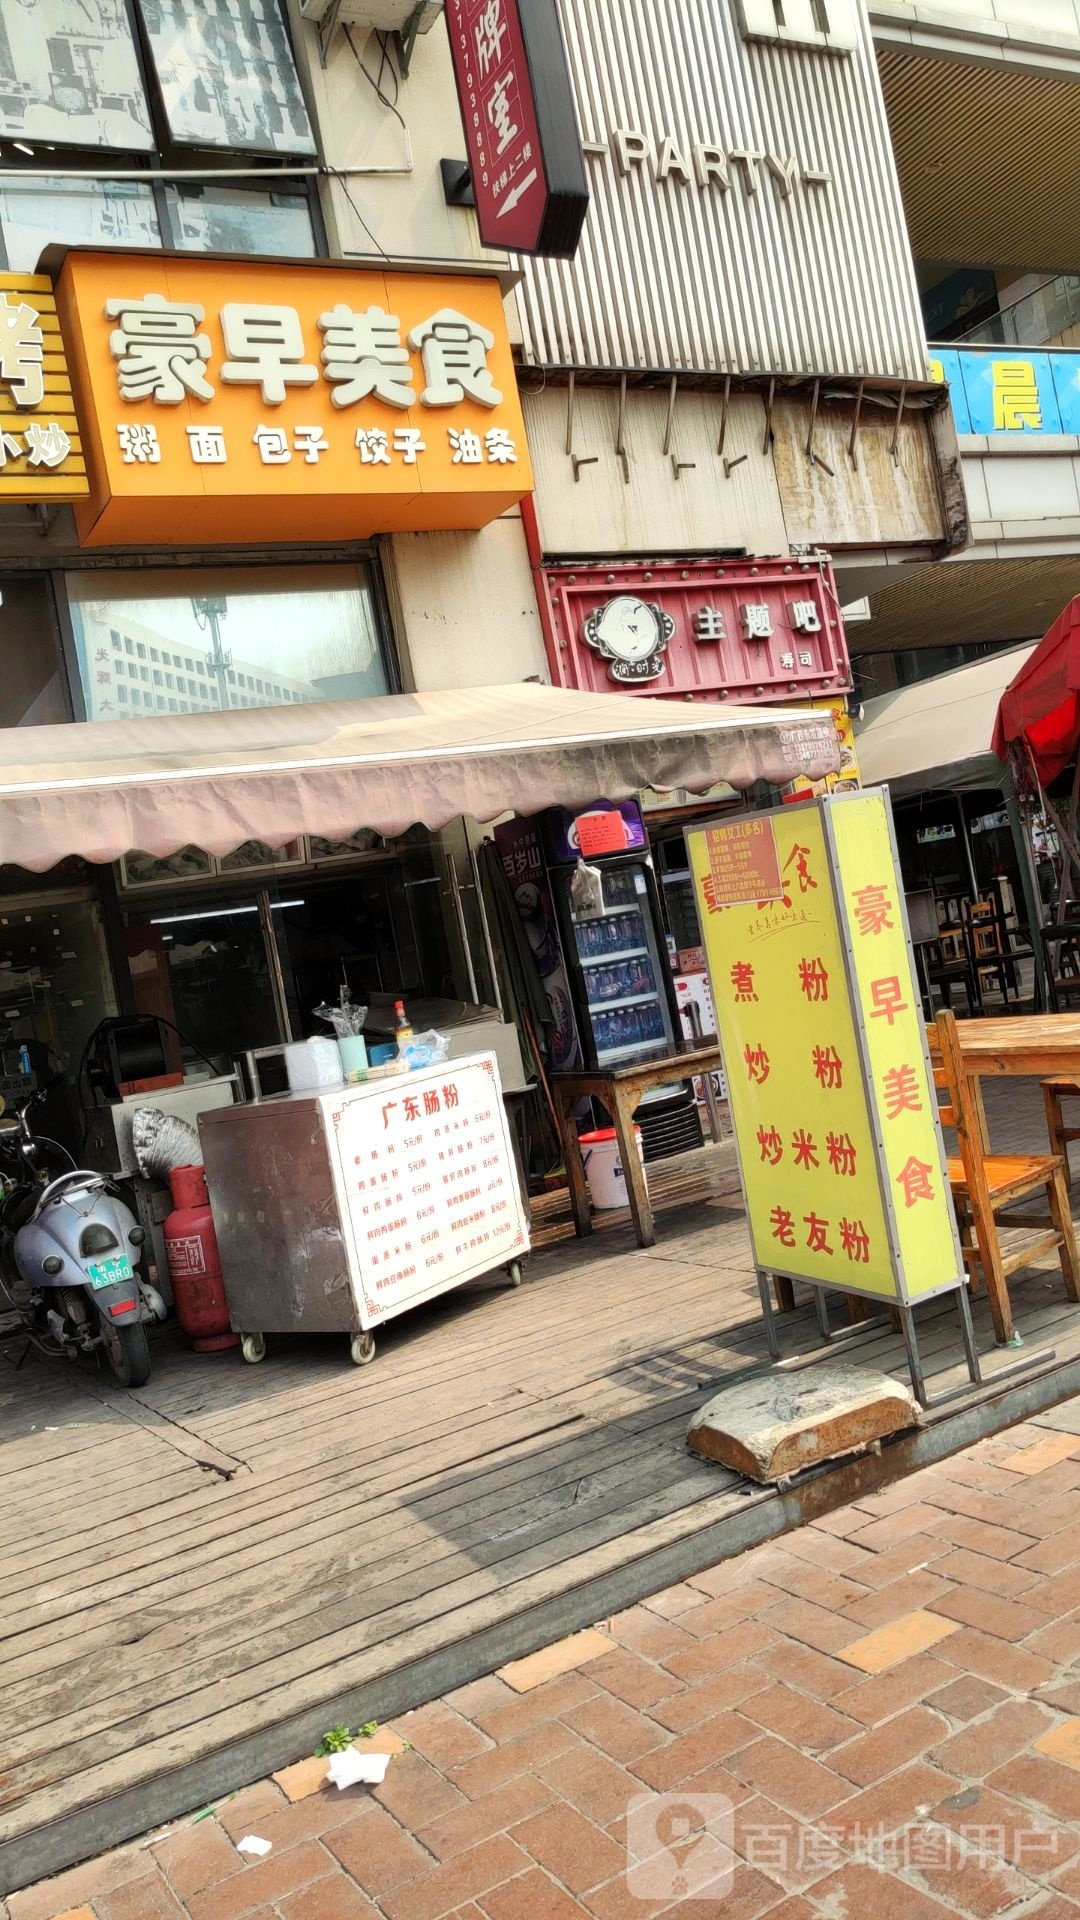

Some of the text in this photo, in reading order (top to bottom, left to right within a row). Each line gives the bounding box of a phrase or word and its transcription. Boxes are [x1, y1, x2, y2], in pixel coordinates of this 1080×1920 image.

[475, 0, 518, 155] 牌室
[103, 293, 503, 410] 豪早美食
[117, 424, 518, 464] 粥 面 包子 饺子 油条
[693, 600, 821, 641] 主题吧
[502, 846, 541, 877] 百岁山
[730, 957, 828, 1002] 煮粉
[744, 1043, 843, 1090] 炒粉
[851, 884, 935, 1209] 豪早美食
[382, 1083, 459, 1131] 广东肠粉
[756, 1124, 857, 1178] 炒米粉
[769, 1205, 870, 1264] 老友粉
